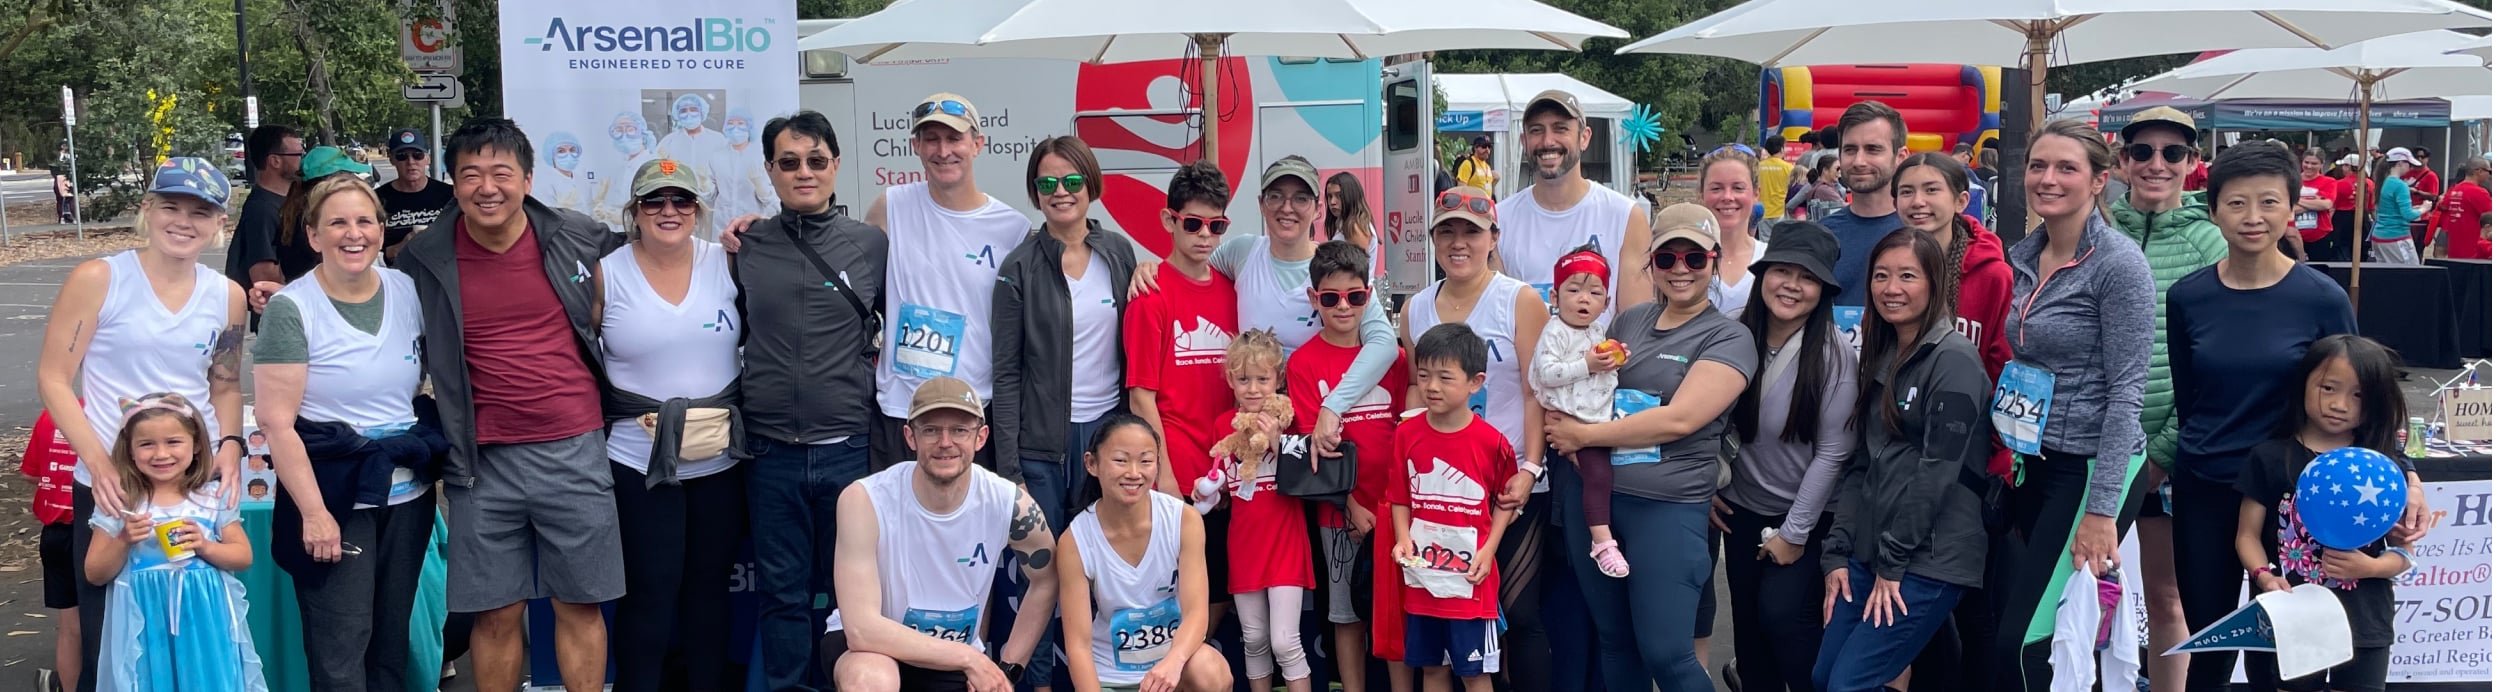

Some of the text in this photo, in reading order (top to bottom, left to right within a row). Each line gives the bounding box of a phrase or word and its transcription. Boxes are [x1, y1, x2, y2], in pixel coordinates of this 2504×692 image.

[569, 59, 745, 69] ENGINEERED TO CURE
[1455, 115, 1469, 125] Up
[2279, 109, 2303, 117] mission
[872, 111, 915, 131] Lucil
[1404, 210, 1424, 224] Lucile
[898, 325, 955, 357] 1201
[1993, 386, 2046, 424] 2254
[2454, 402, 2492, 416] HOM
[2451, 538, 2475, 556] Its
[1116, 618, 1179, 651] 2386
[2194, 626, 2253, 648] SAN JOSE
[2412, 628, 2473, 644] Greater
[2391, 650, 2440, 665] oastal
[2455, 668, 2489, 677] operated
